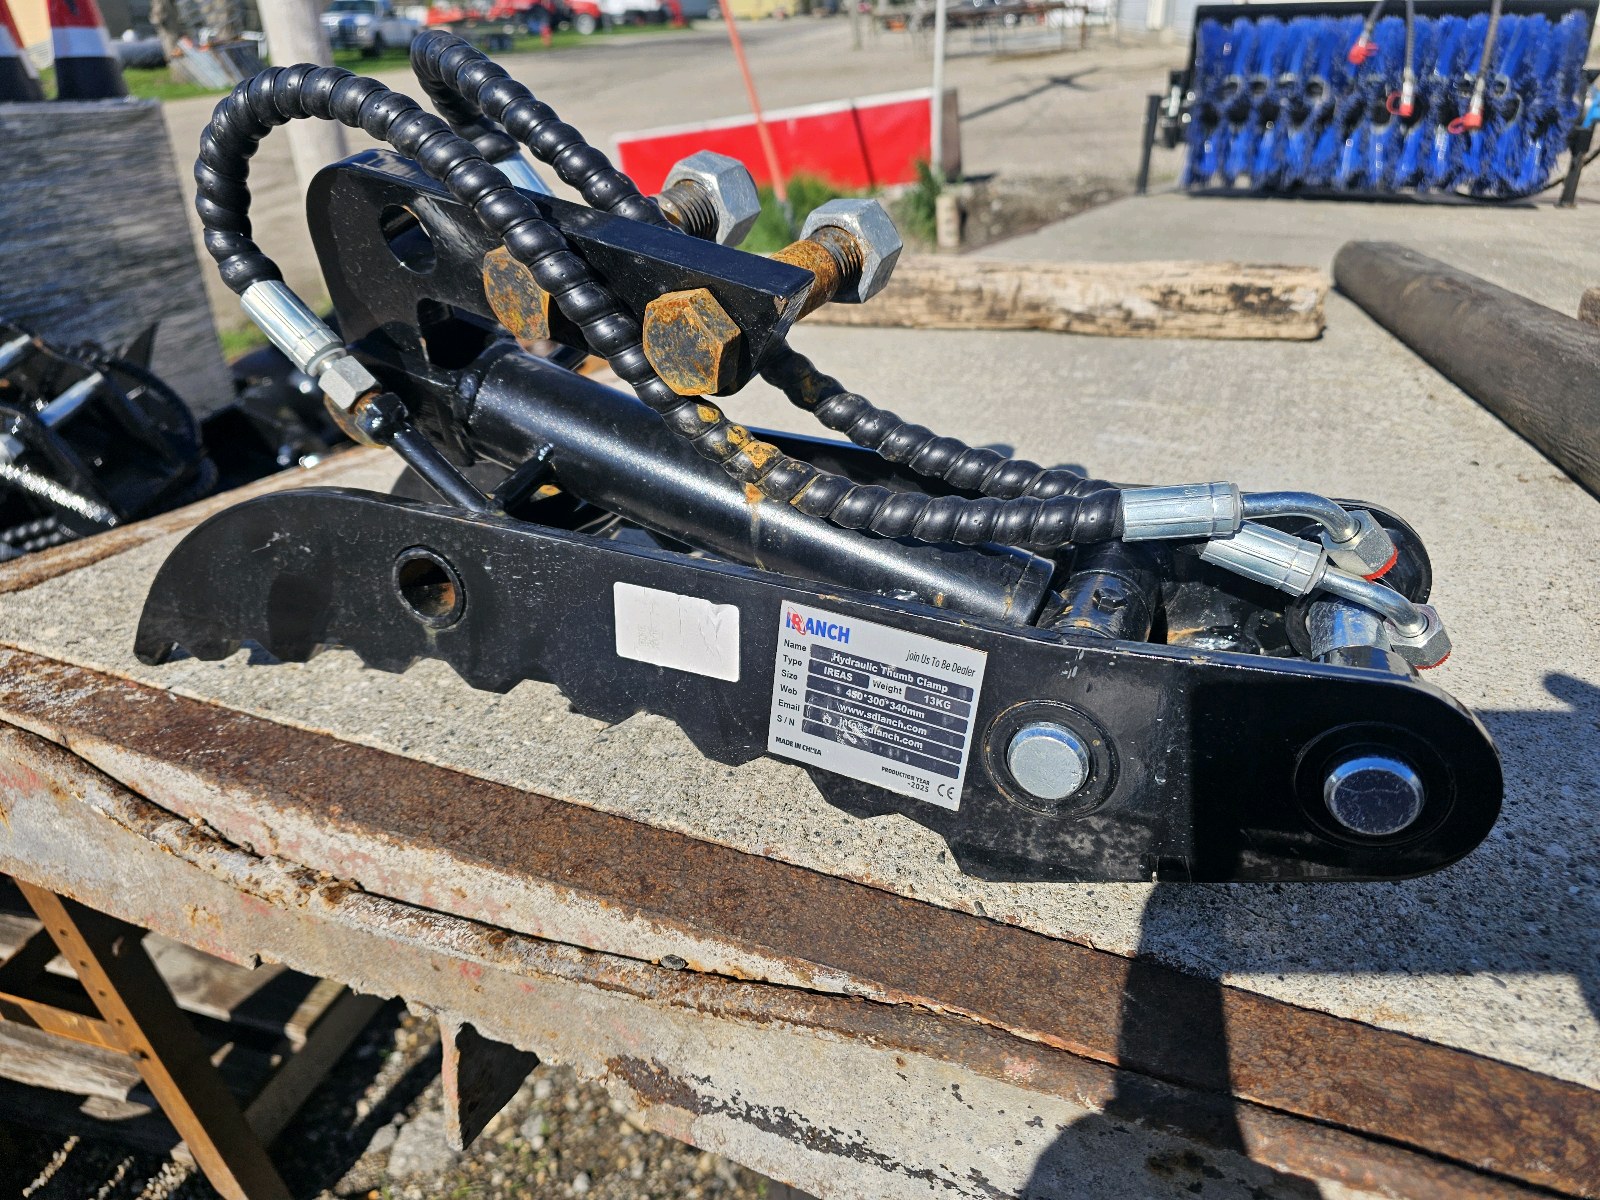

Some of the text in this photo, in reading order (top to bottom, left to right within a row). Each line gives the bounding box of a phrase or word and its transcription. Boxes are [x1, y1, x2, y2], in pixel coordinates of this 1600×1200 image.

[783, 639, 807, 652] Name
[783, 654, 803, 667] Type
[921, 653, 931, 665] Us
[931, 656, 941, 668] To
[941, 659, 951, 671] Be
[952, 662, 976, 677] Dealer
[781, 669, 798, 681] Size
[824, 666, 853, 681] IREAS
[832, 652, 949, 694] Hydraulic Thumb Clamp
[780, 684, 798, 695] Web
[873, 679, 902, 695] Weight
[778, 698, 800, 712] Email
[924, 694, 951, 710] 13KG
[775, 736, 794, 748] MADE
[794, 741, 802, 750] IN
[881, 766, 930, 786] PRODUCTION YEAR
